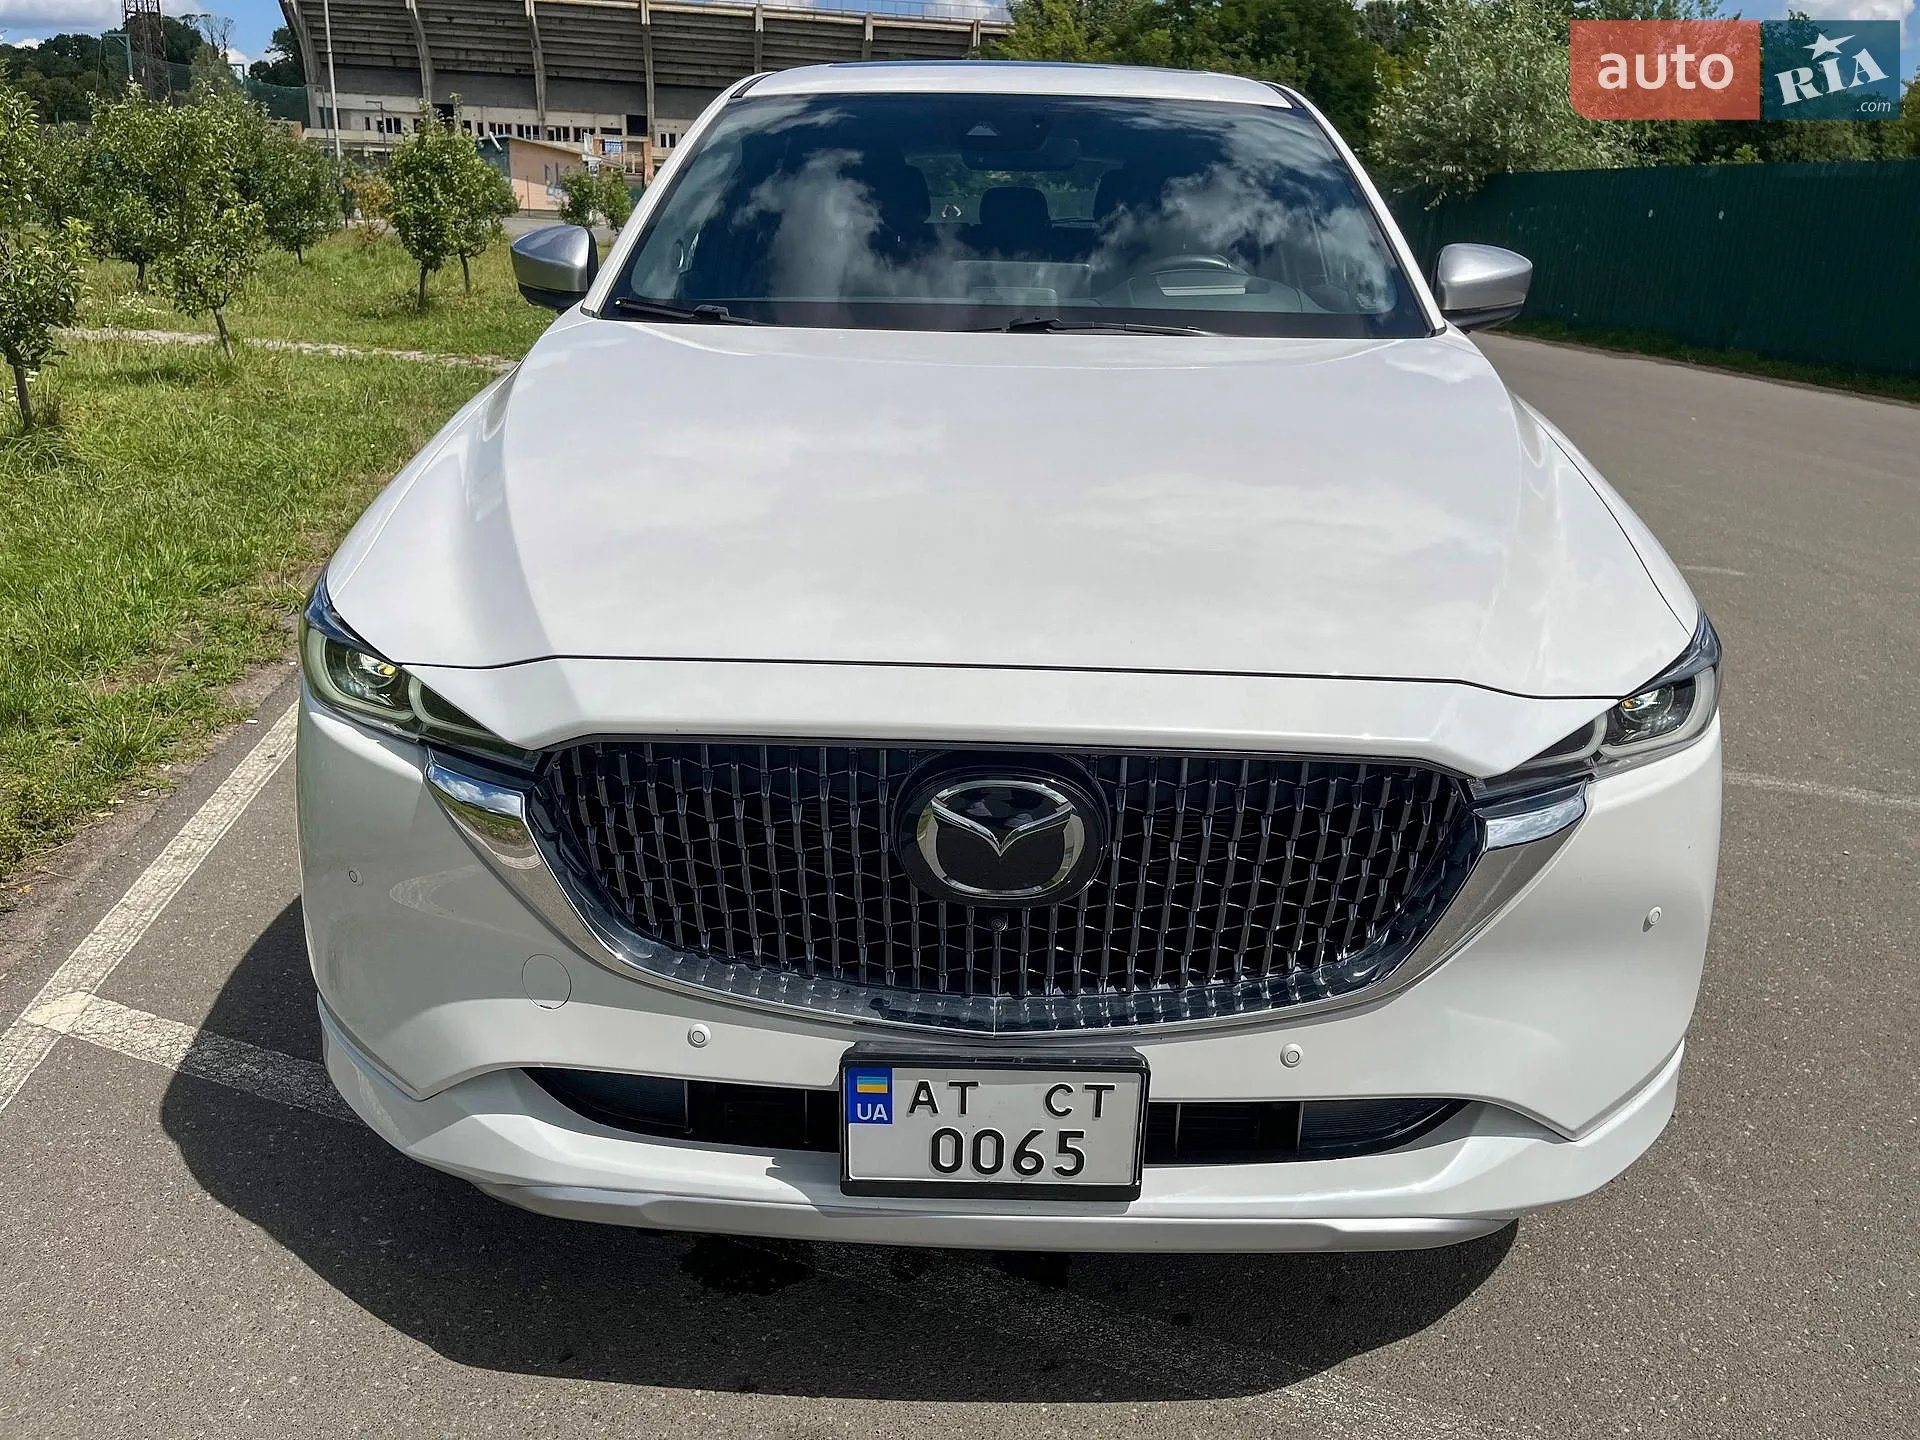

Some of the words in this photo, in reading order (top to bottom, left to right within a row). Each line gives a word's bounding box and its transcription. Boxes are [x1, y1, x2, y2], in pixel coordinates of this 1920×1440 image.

[857, 1102, 889, 1121] UA
[909, 1080, 979, 1115] AT
[1045, 1083, 1116, 1118] CT
[930, 1127, 1086, 1176] 0065
